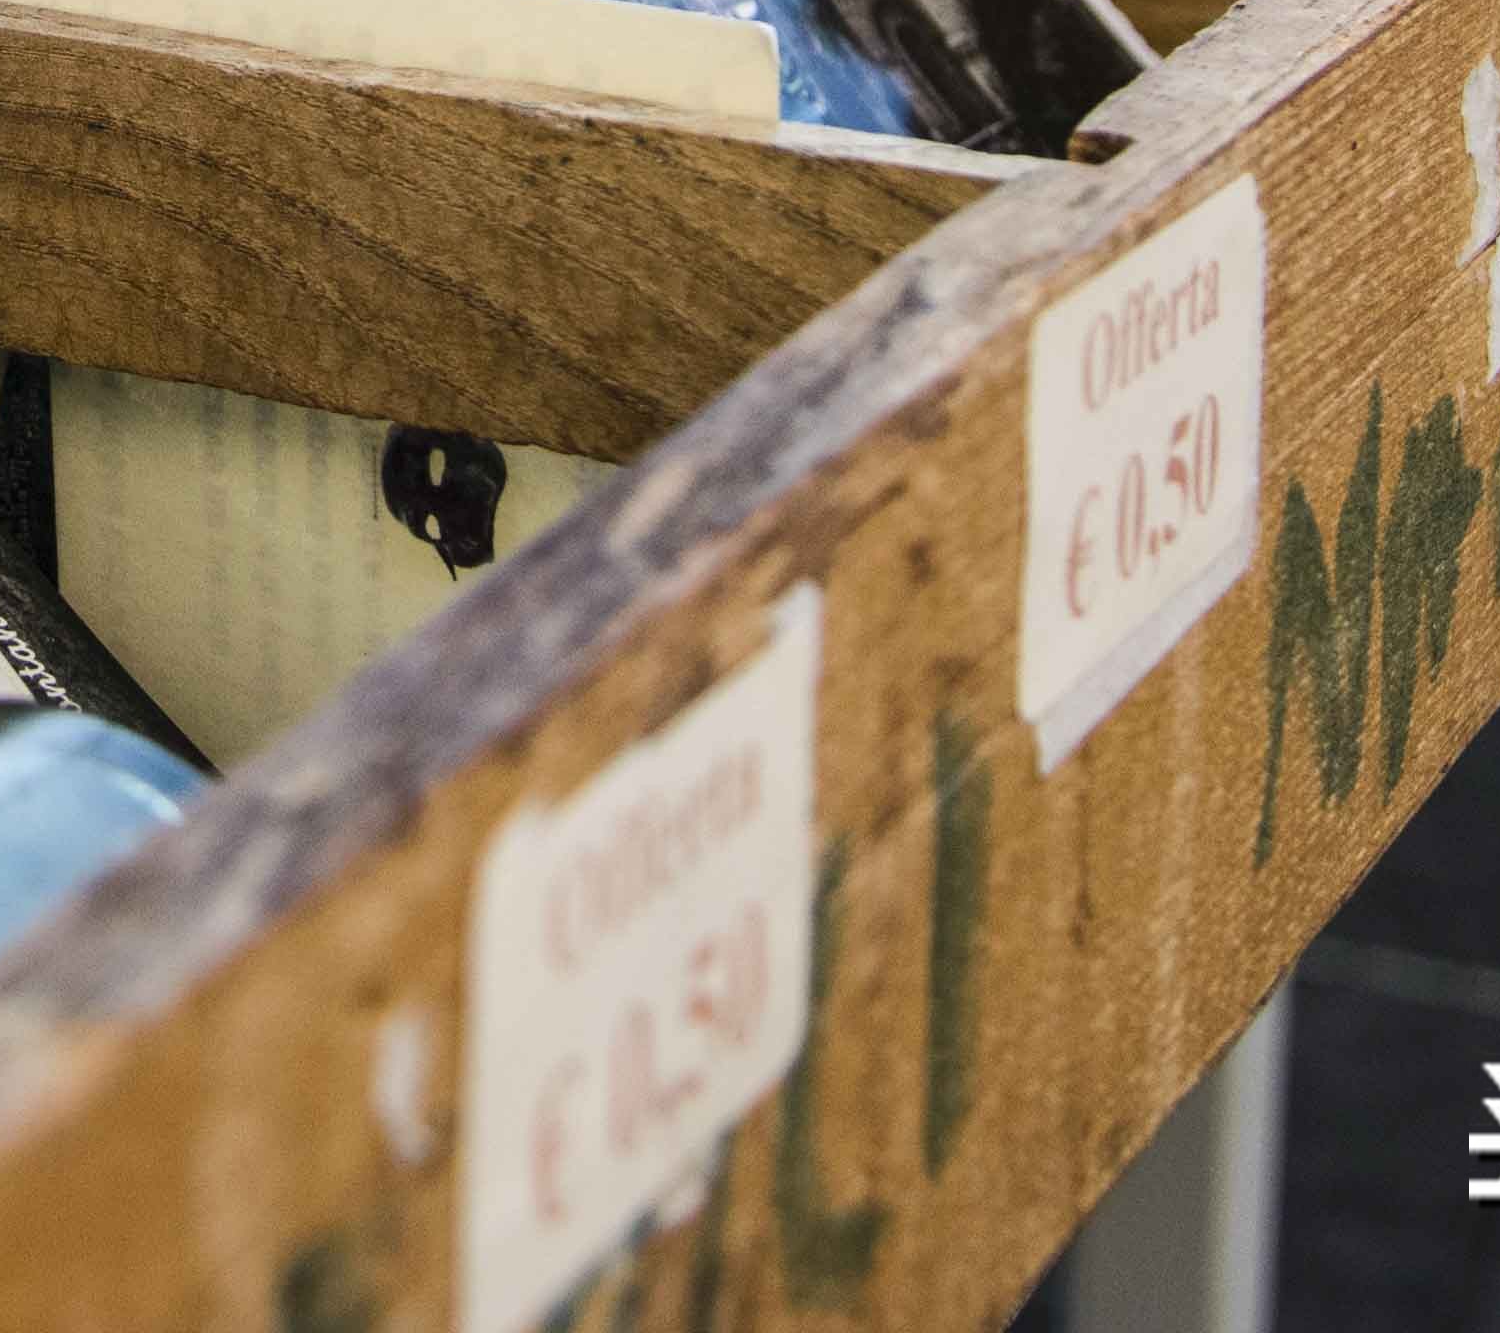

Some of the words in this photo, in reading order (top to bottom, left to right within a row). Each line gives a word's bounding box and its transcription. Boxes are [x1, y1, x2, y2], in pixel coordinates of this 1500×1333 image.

[1080, 258, 1220, 413] Offerta
[1064, 484, 1101, 620] €
[1114, 391, 1220, 579] 0,50
